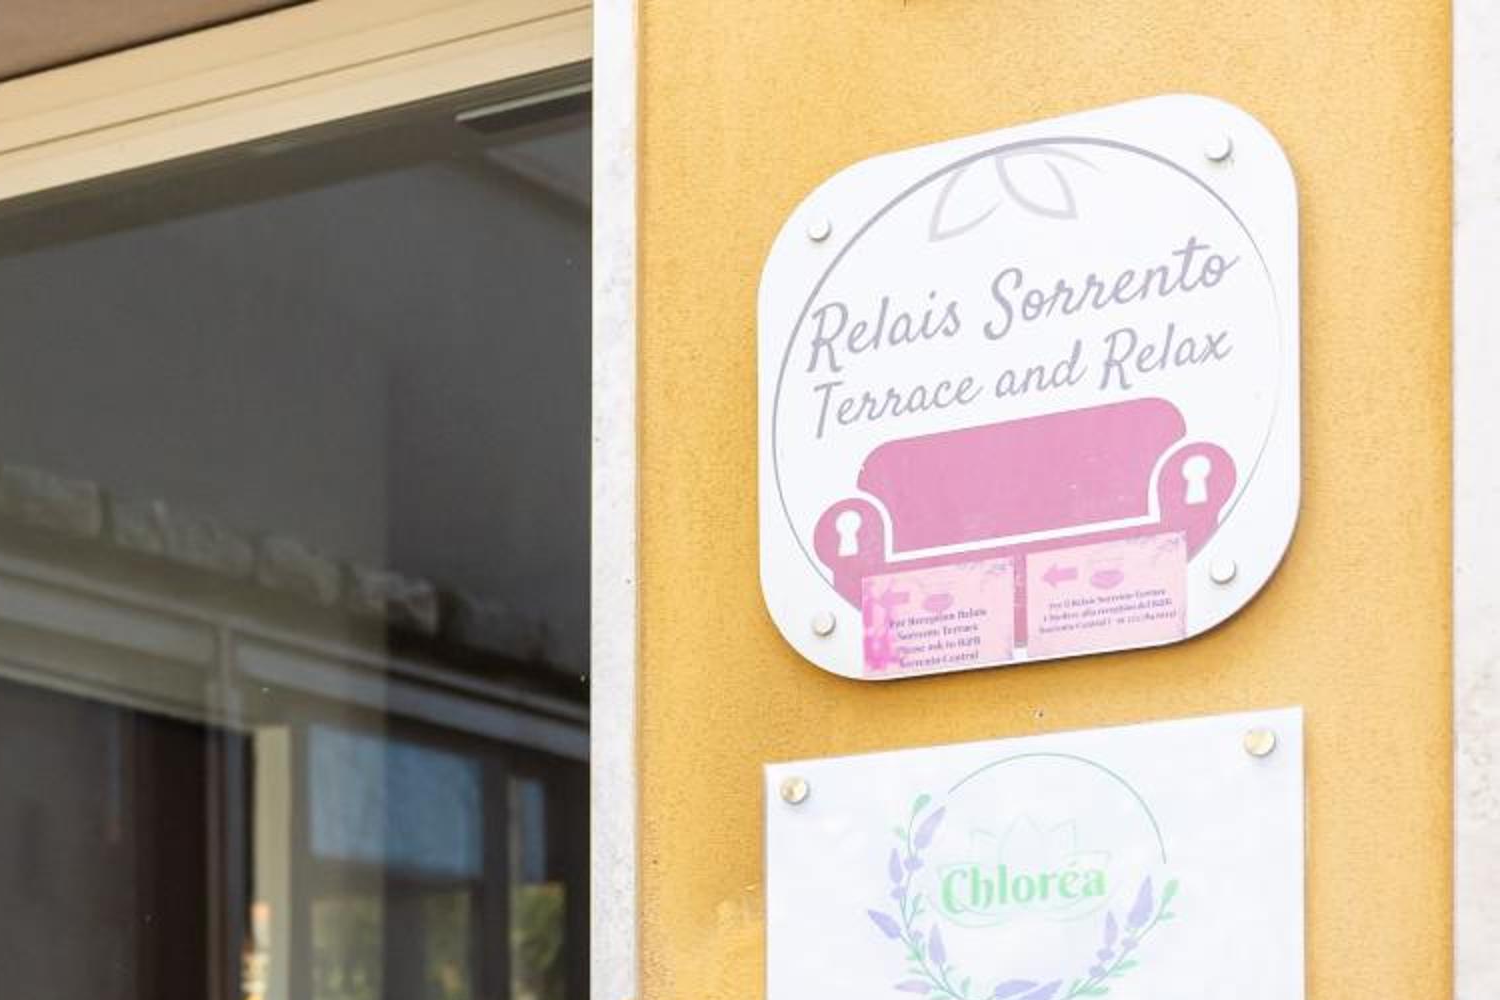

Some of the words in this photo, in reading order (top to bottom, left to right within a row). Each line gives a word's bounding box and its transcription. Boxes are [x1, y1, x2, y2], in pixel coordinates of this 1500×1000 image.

[807, 291, 962, 372] Relais
[982, 236, 1241, 342] Sorrento
[812, 372, 985, 440] Terrace
[994, 339, 1090, 399] and
[1098, 323, 1234, 393] Relax
